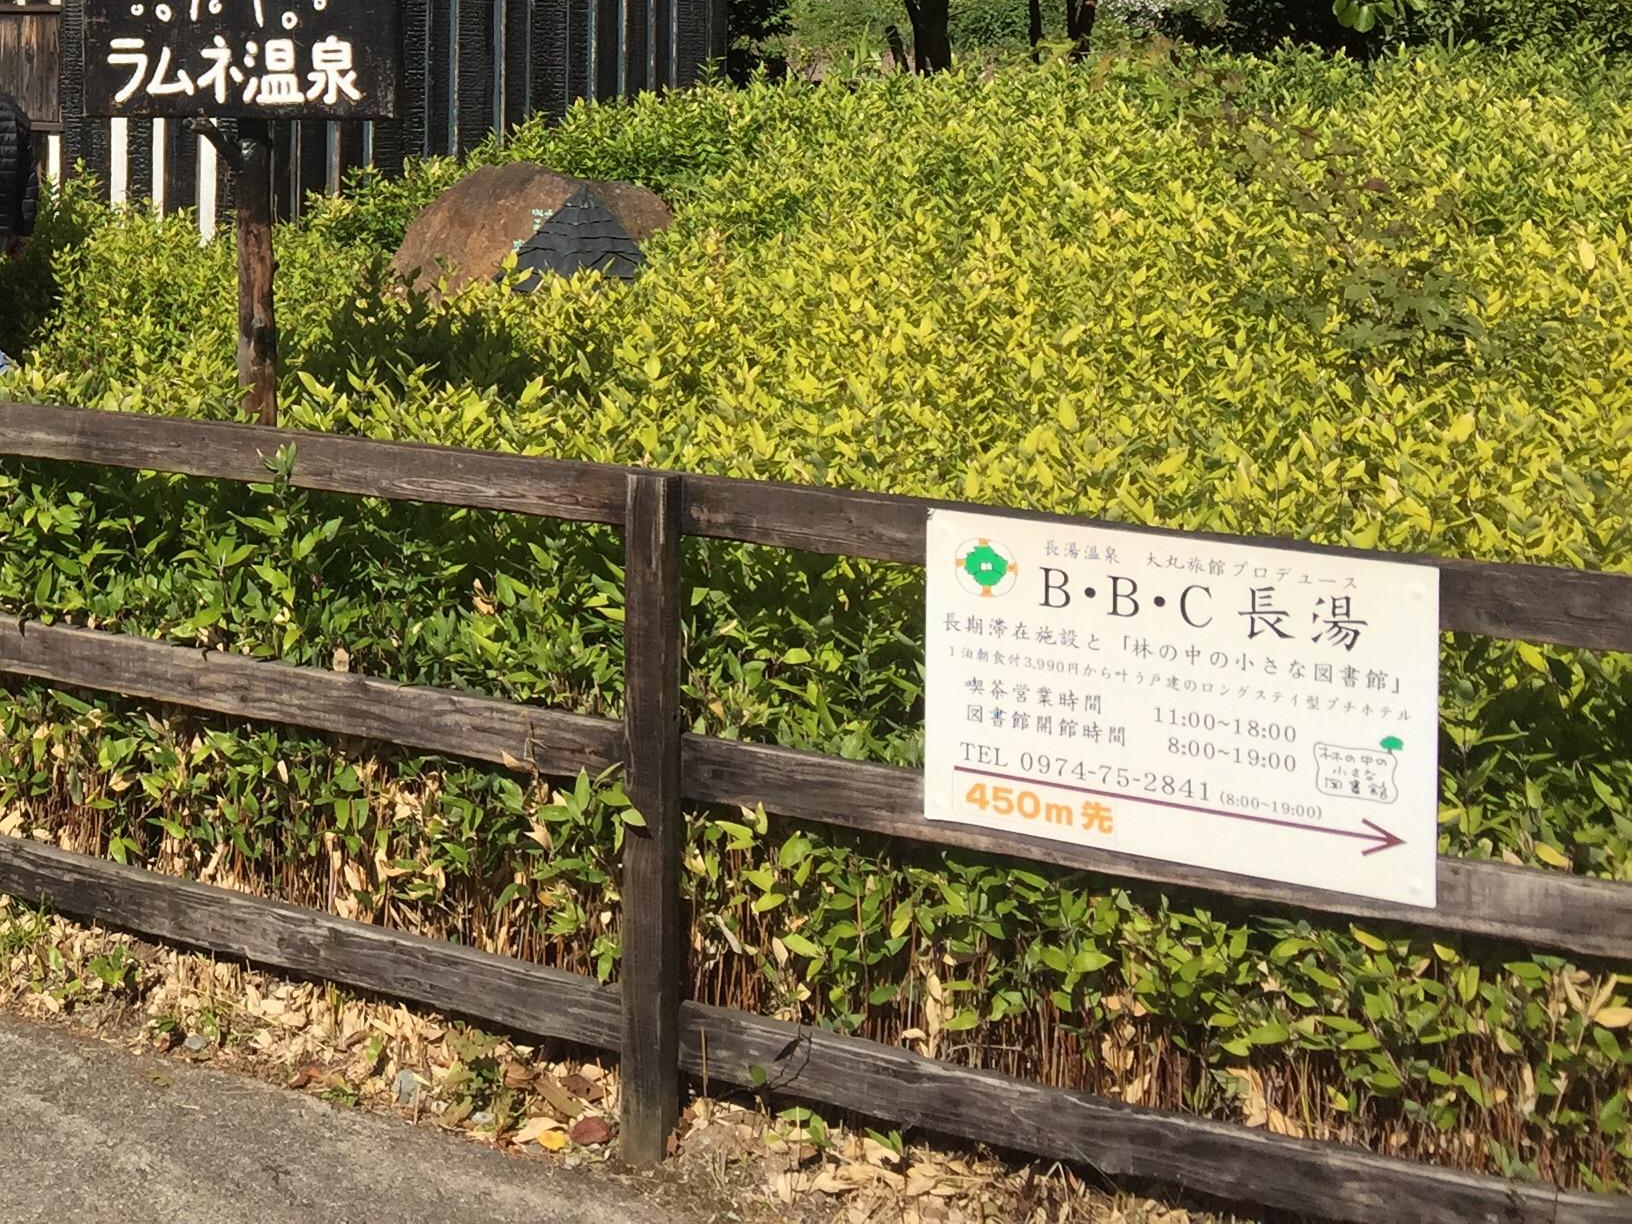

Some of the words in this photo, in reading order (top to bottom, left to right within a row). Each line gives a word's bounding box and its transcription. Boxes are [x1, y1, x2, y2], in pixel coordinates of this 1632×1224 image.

[107, 35, 364, 105] ラムネ温泉
[1043, 538, 1120, 564] 長湯温泉
[1237, 586, 1369, 652] 長湯
[965, 676, 1102, 715] 喫茶営業時間
[966, 704, 1126, 747] 図書館開館時間
[960, 741, 1009, 768] TEL
[1020, 751, 1211, 802] 0974-75-2841
